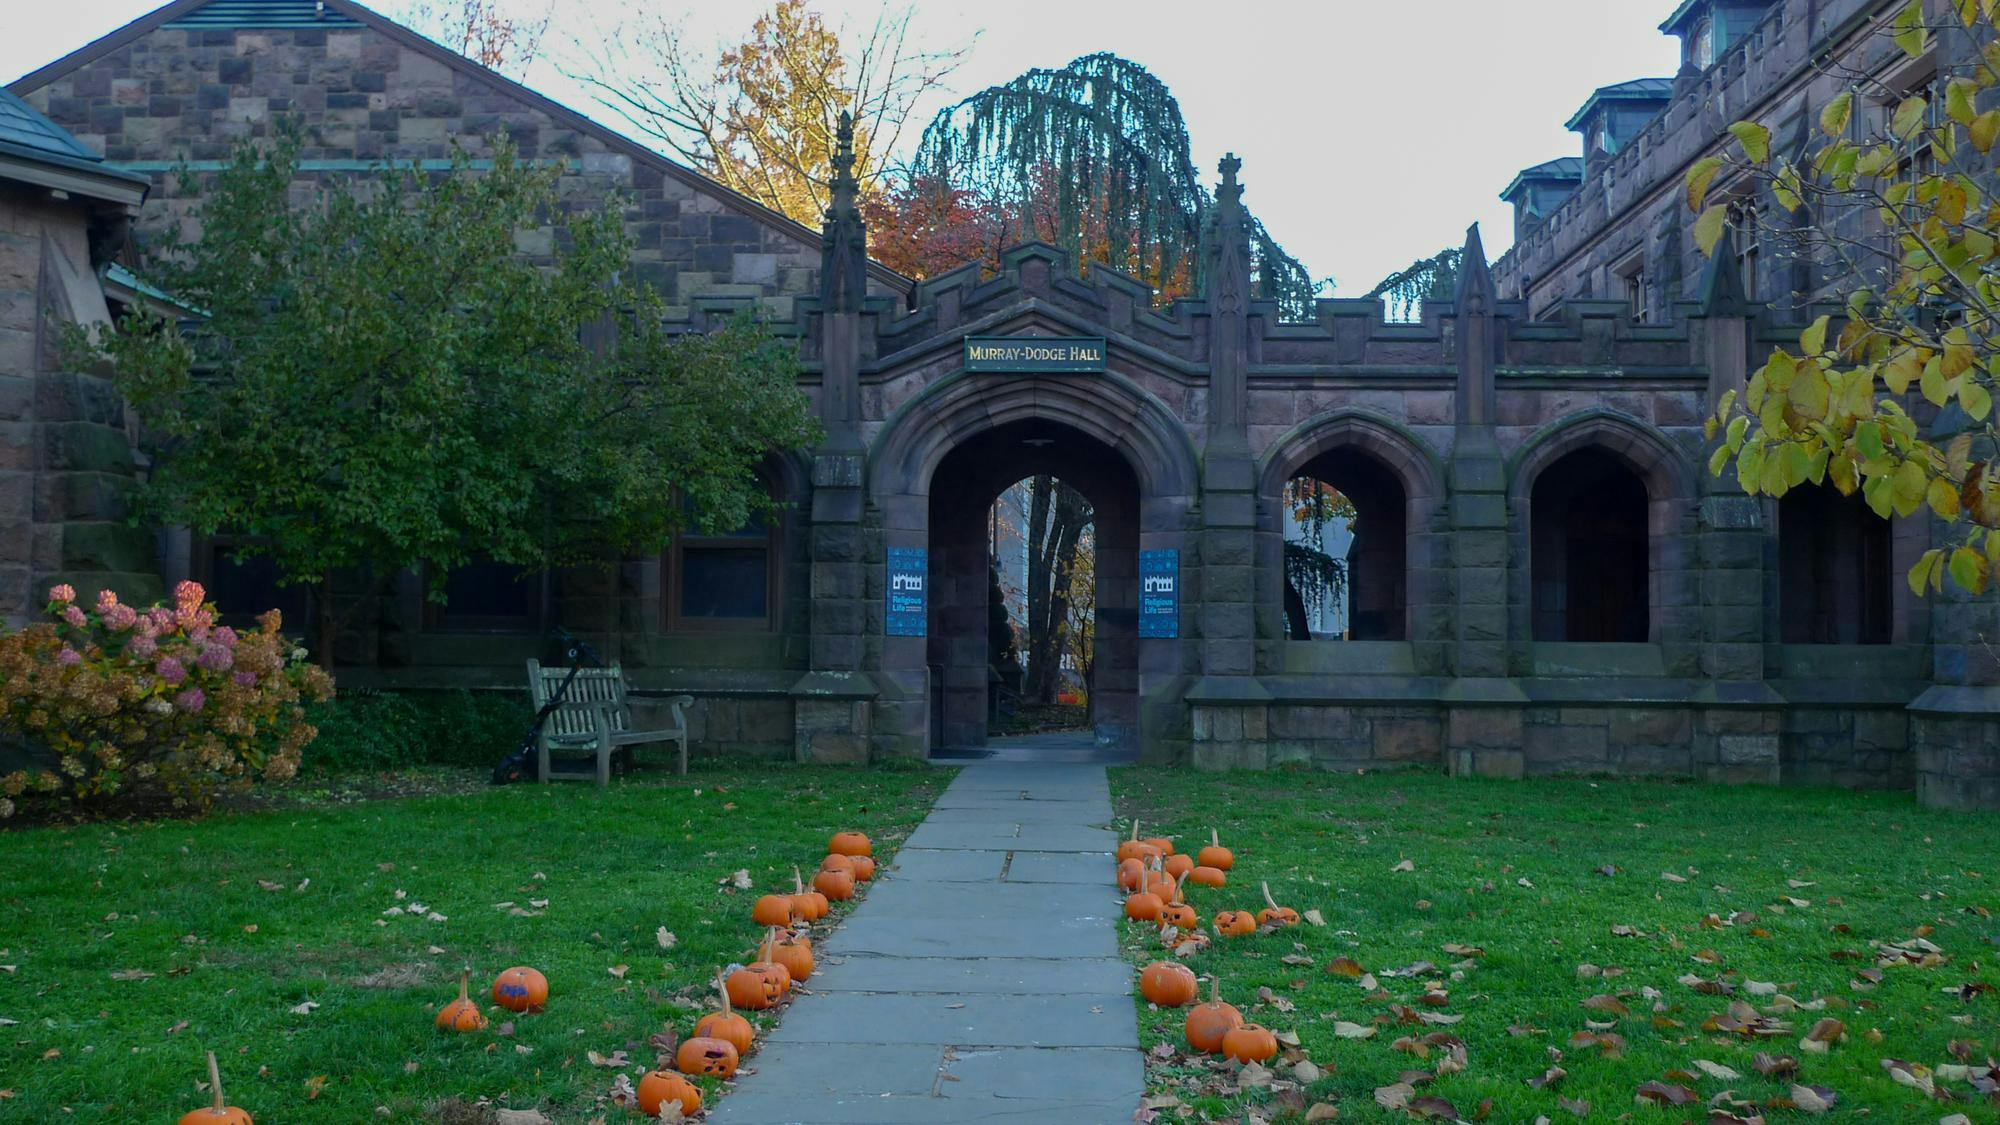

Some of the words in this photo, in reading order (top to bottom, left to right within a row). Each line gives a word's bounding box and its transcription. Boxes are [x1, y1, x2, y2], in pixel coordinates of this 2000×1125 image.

[969, 346, 1066, 361] MURRAY-DODGE
[1070, 346, 1101, 361] HALL
[893, 596, 921, 606] Religious
[1145, 598, 1173, 607] Religious
[893, 604, 905, 612] Life
[1145, 606, 1157, 614] Life
